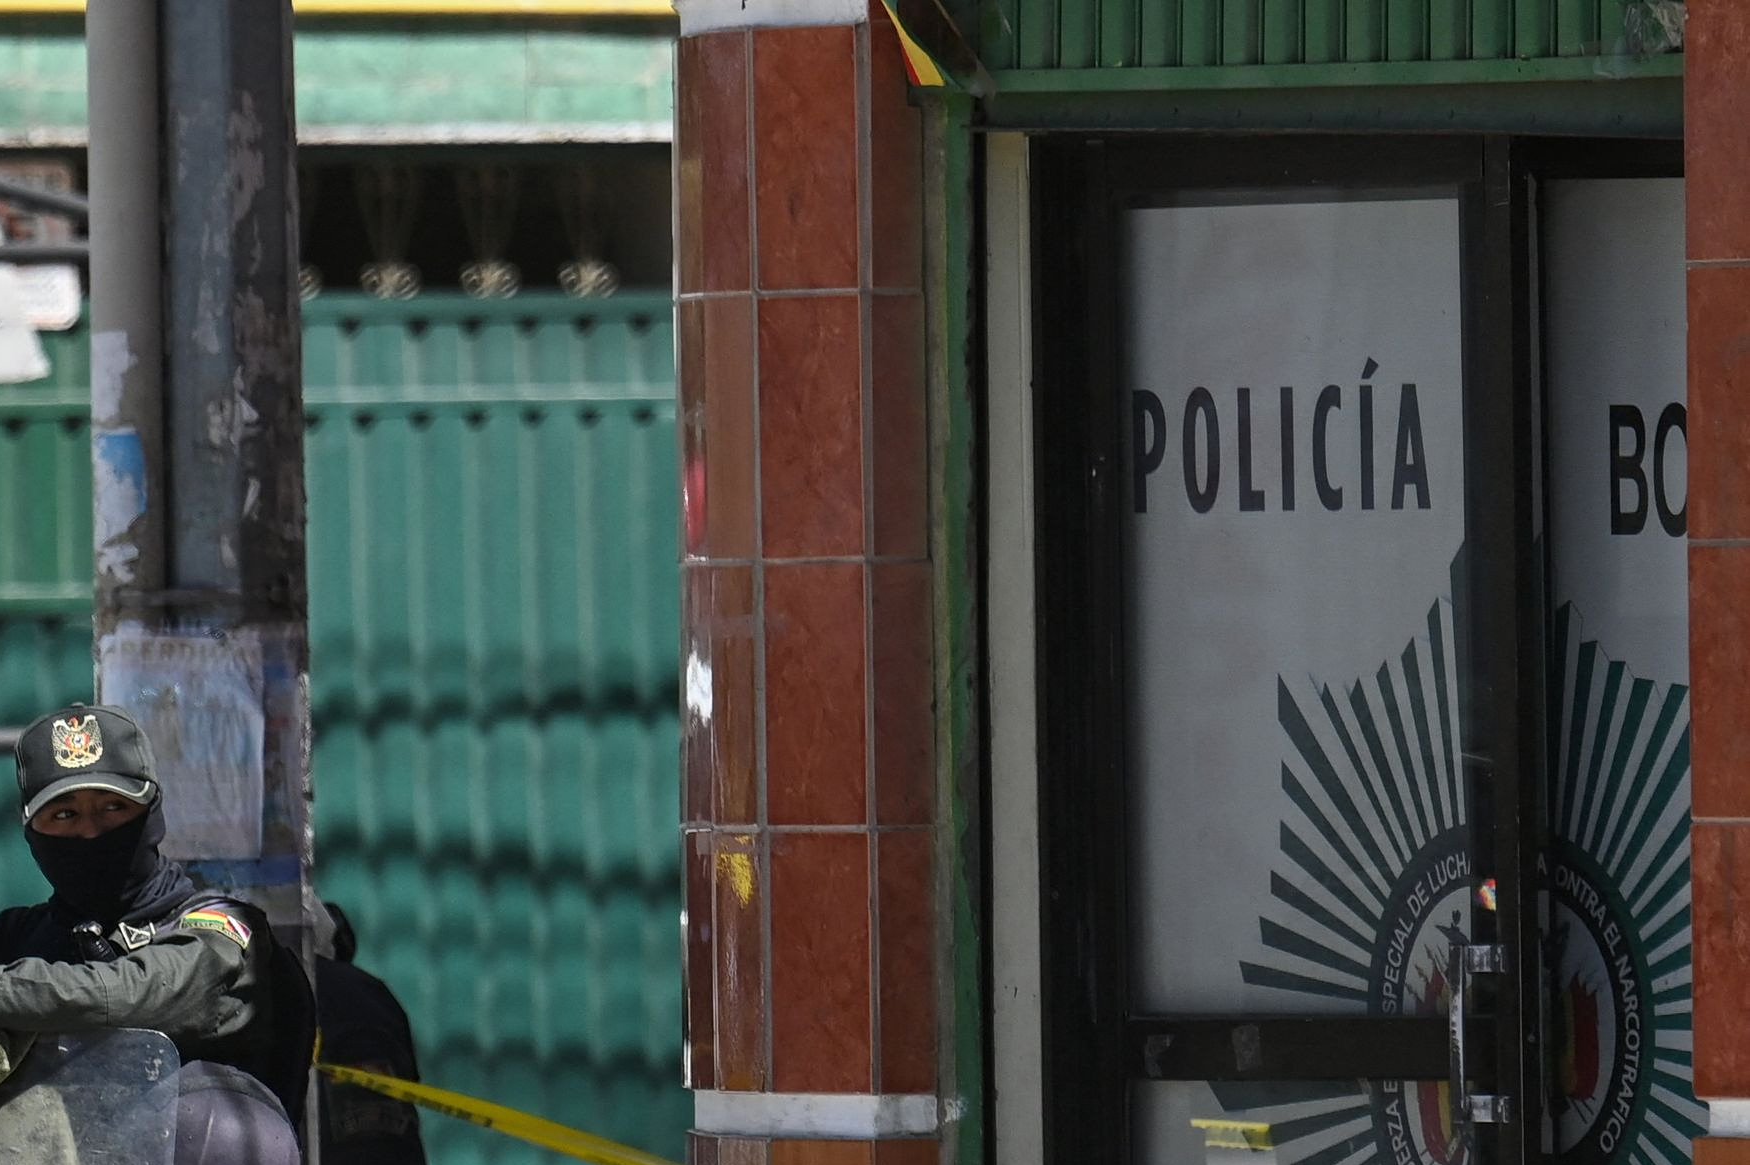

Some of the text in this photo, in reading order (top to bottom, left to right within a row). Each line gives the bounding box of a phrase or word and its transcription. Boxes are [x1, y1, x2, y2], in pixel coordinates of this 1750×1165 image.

[1132, 356, 1432, 514] POLICÍA
[1408, 889, 1430, 915] DE
[1554, 865, 1608, 923] ONTRA
[1604, 923, 1622, 953] EL
[1598, 954, 1639, 1155] NARCOTRAFICO
